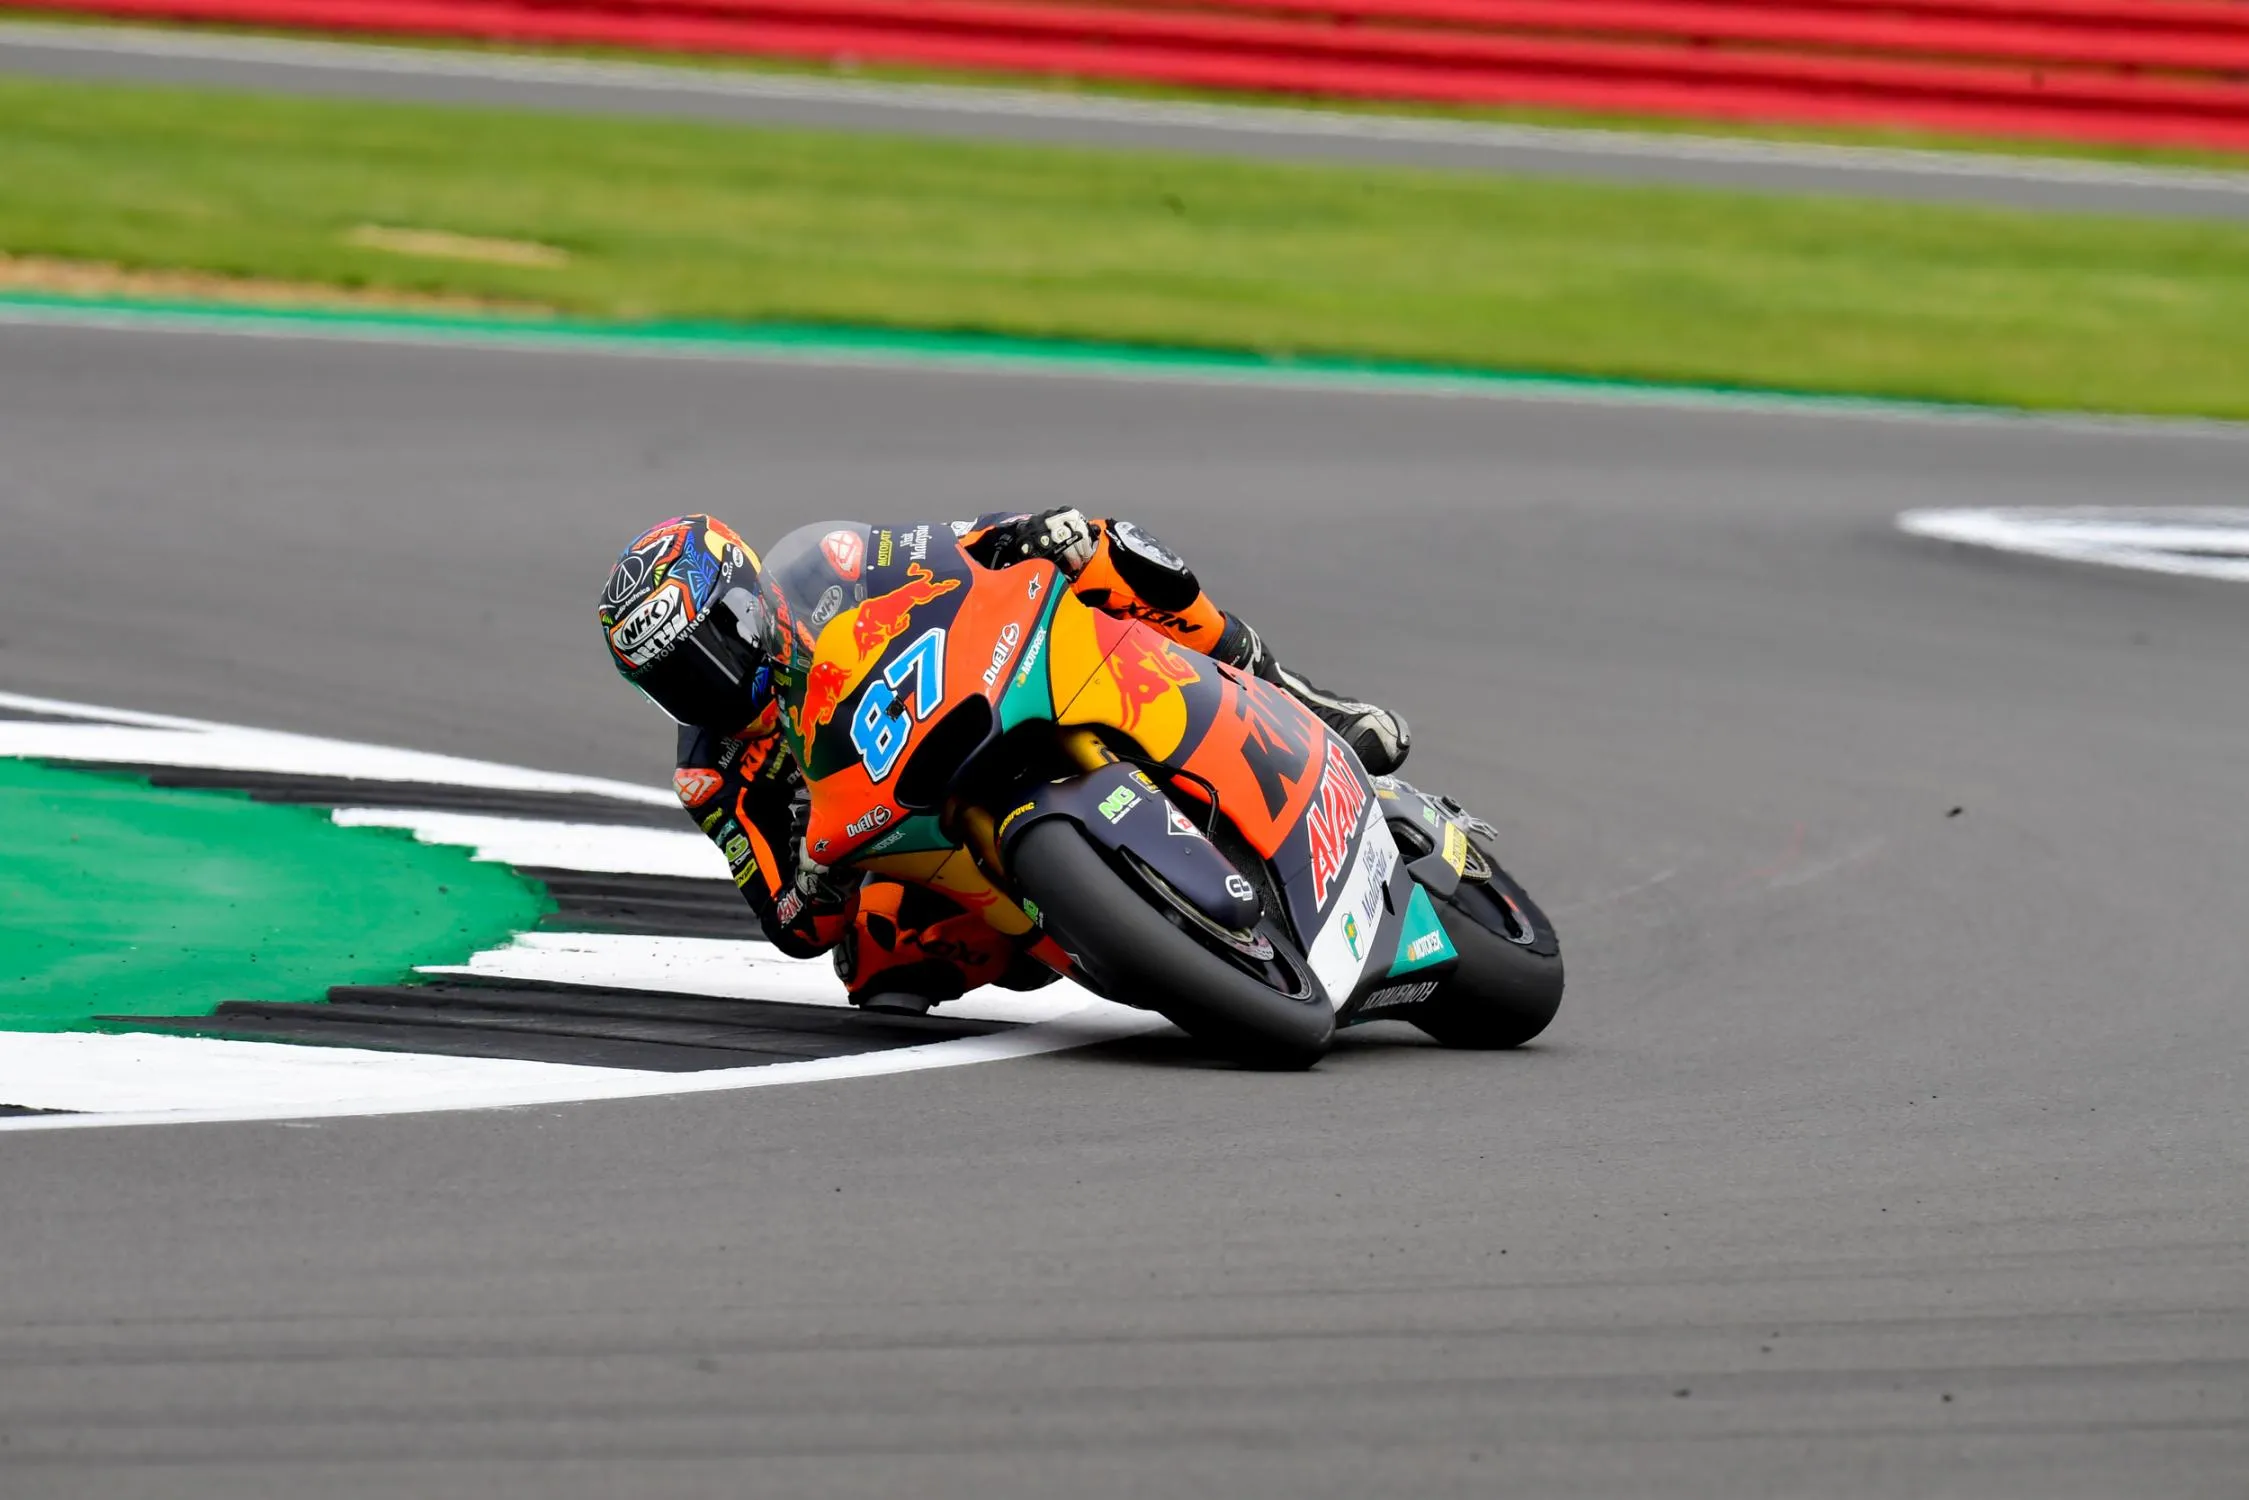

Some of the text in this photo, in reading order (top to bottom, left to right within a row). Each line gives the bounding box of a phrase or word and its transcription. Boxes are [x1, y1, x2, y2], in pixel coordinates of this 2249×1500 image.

[910, 525, 932, 560] Malaysia
[655, 644, 676, 662] YOU
[677, 608, 711, 642] WINGS
[1022, 627, 1048, 676] MOTOREX
[850, 627, 947, 784] 87
[1098, 785, 1136, 821] NG
